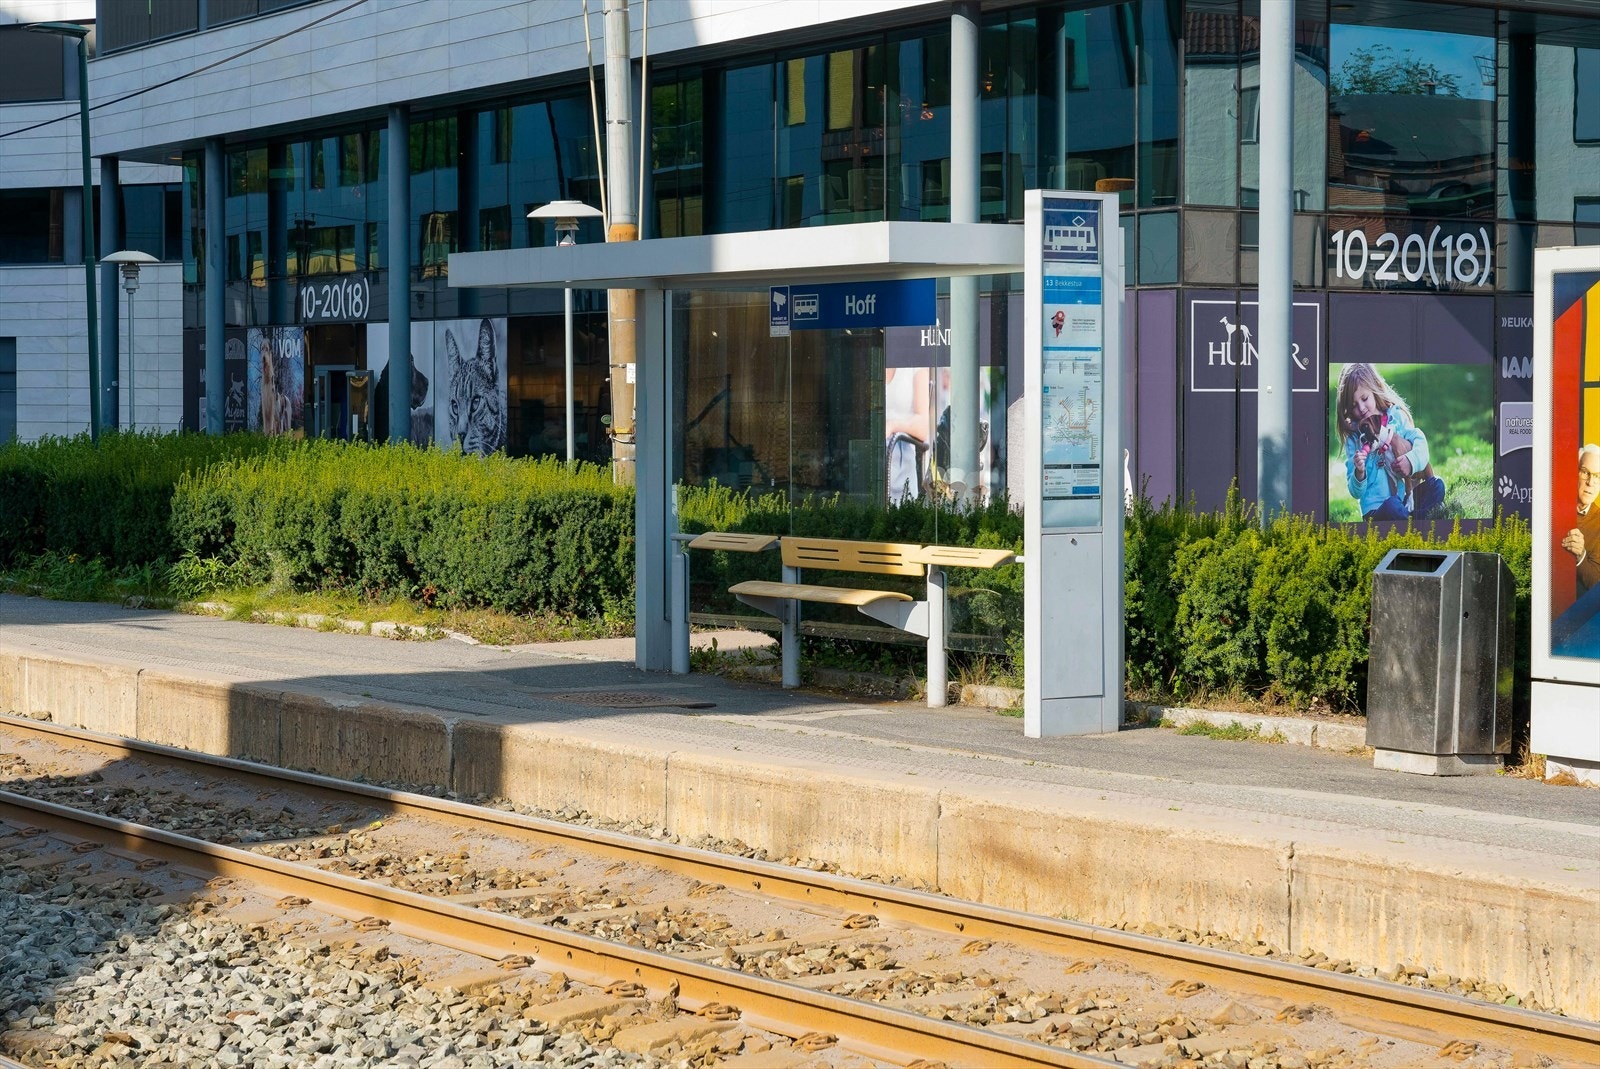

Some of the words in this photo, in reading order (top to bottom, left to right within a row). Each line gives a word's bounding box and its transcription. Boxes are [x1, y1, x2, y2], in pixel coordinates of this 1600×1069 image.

[1331, 225, 1491, 287] 10-20(18)
[301, 277, 370, 319] 10-20(18)
[845, 294, 876, 315] Hoff
[279, 339, 301, 358] VOM
[1208, 341, 1307, 370] HUNR
